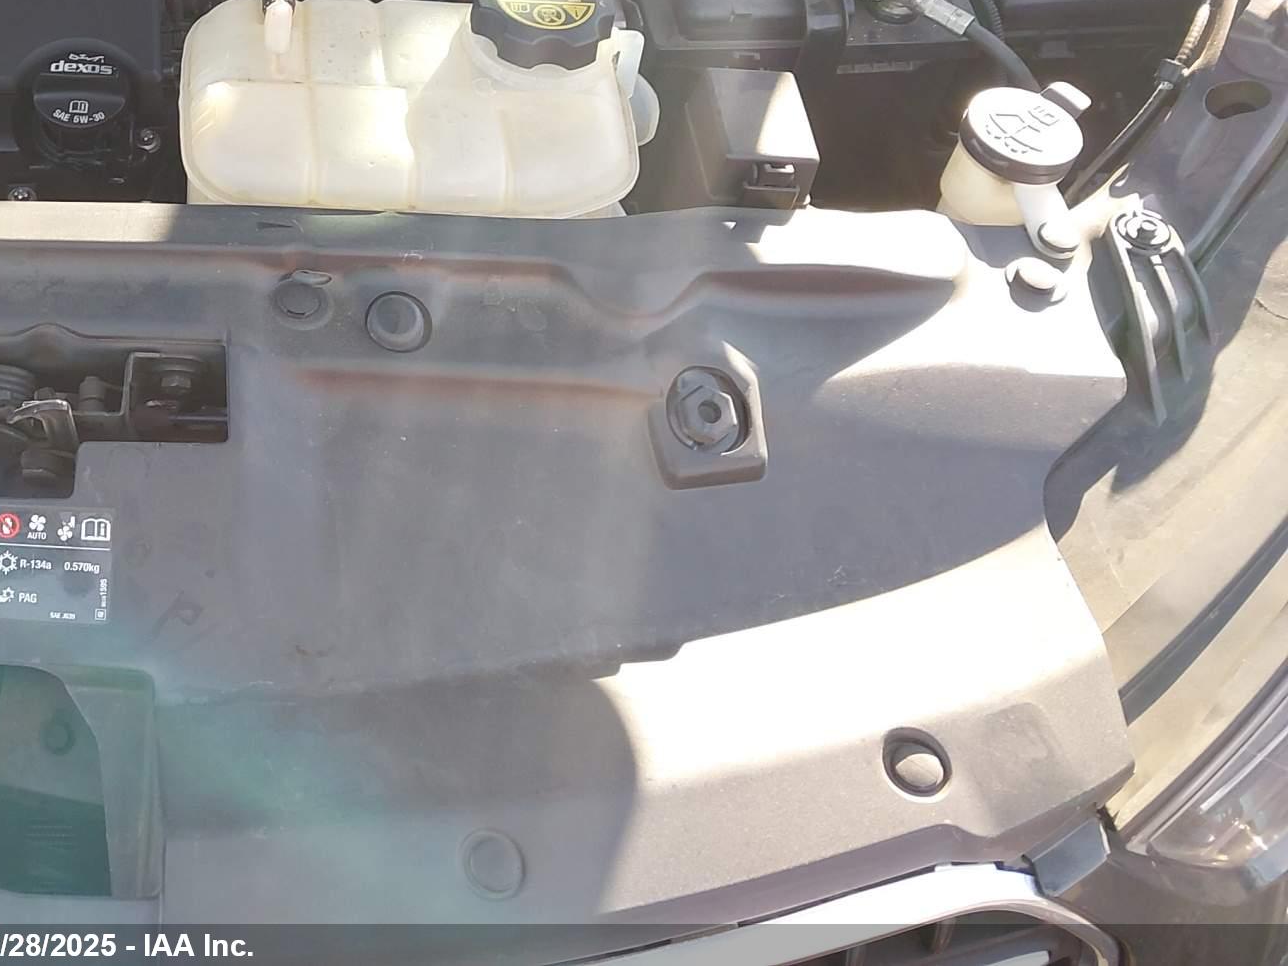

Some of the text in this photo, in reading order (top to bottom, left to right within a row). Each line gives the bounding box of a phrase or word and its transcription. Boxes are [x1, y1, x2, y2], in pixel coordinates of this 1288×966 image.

[50, 60, 112, 74] dexos
[53, 109, 105, 124] SAE 5W-30
[27, 532, 46, 540] AUTO
[20, 559, 100, 574] R-134a 0.570kg
[18, 593, 37, 603] PAG
